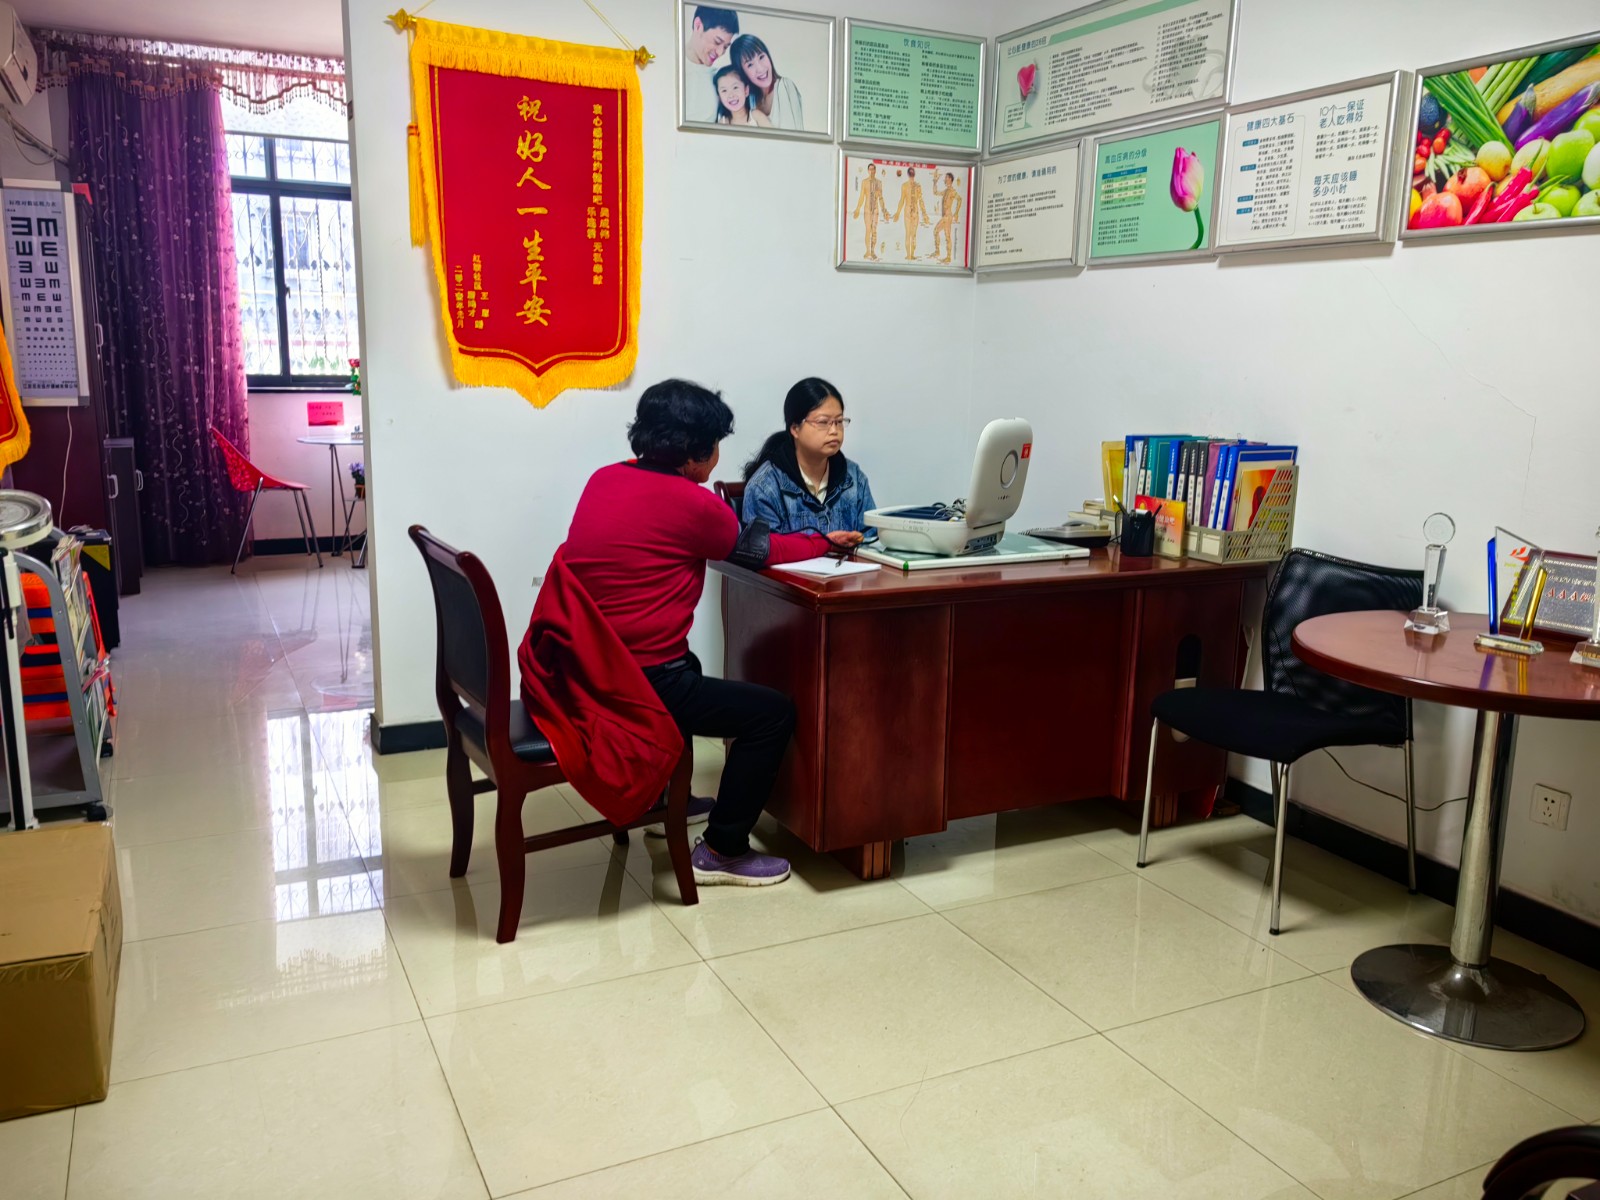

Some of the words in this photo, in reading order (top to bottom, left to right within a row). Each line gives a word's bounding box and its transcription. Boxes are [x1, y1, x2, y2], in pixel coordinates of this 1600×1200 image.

[904, 38, 931, 49] 饮食知识
[1247, 113, 1295, 131] 健康四大基石
[1319, 111, 1363, 129] 老人吃得好
[1313, 170, 1358, 186] 每天应该睡
[1312, 184, 1347, 198] 多少小时
[516, 95, 552, 326] 祝好人一生平安
